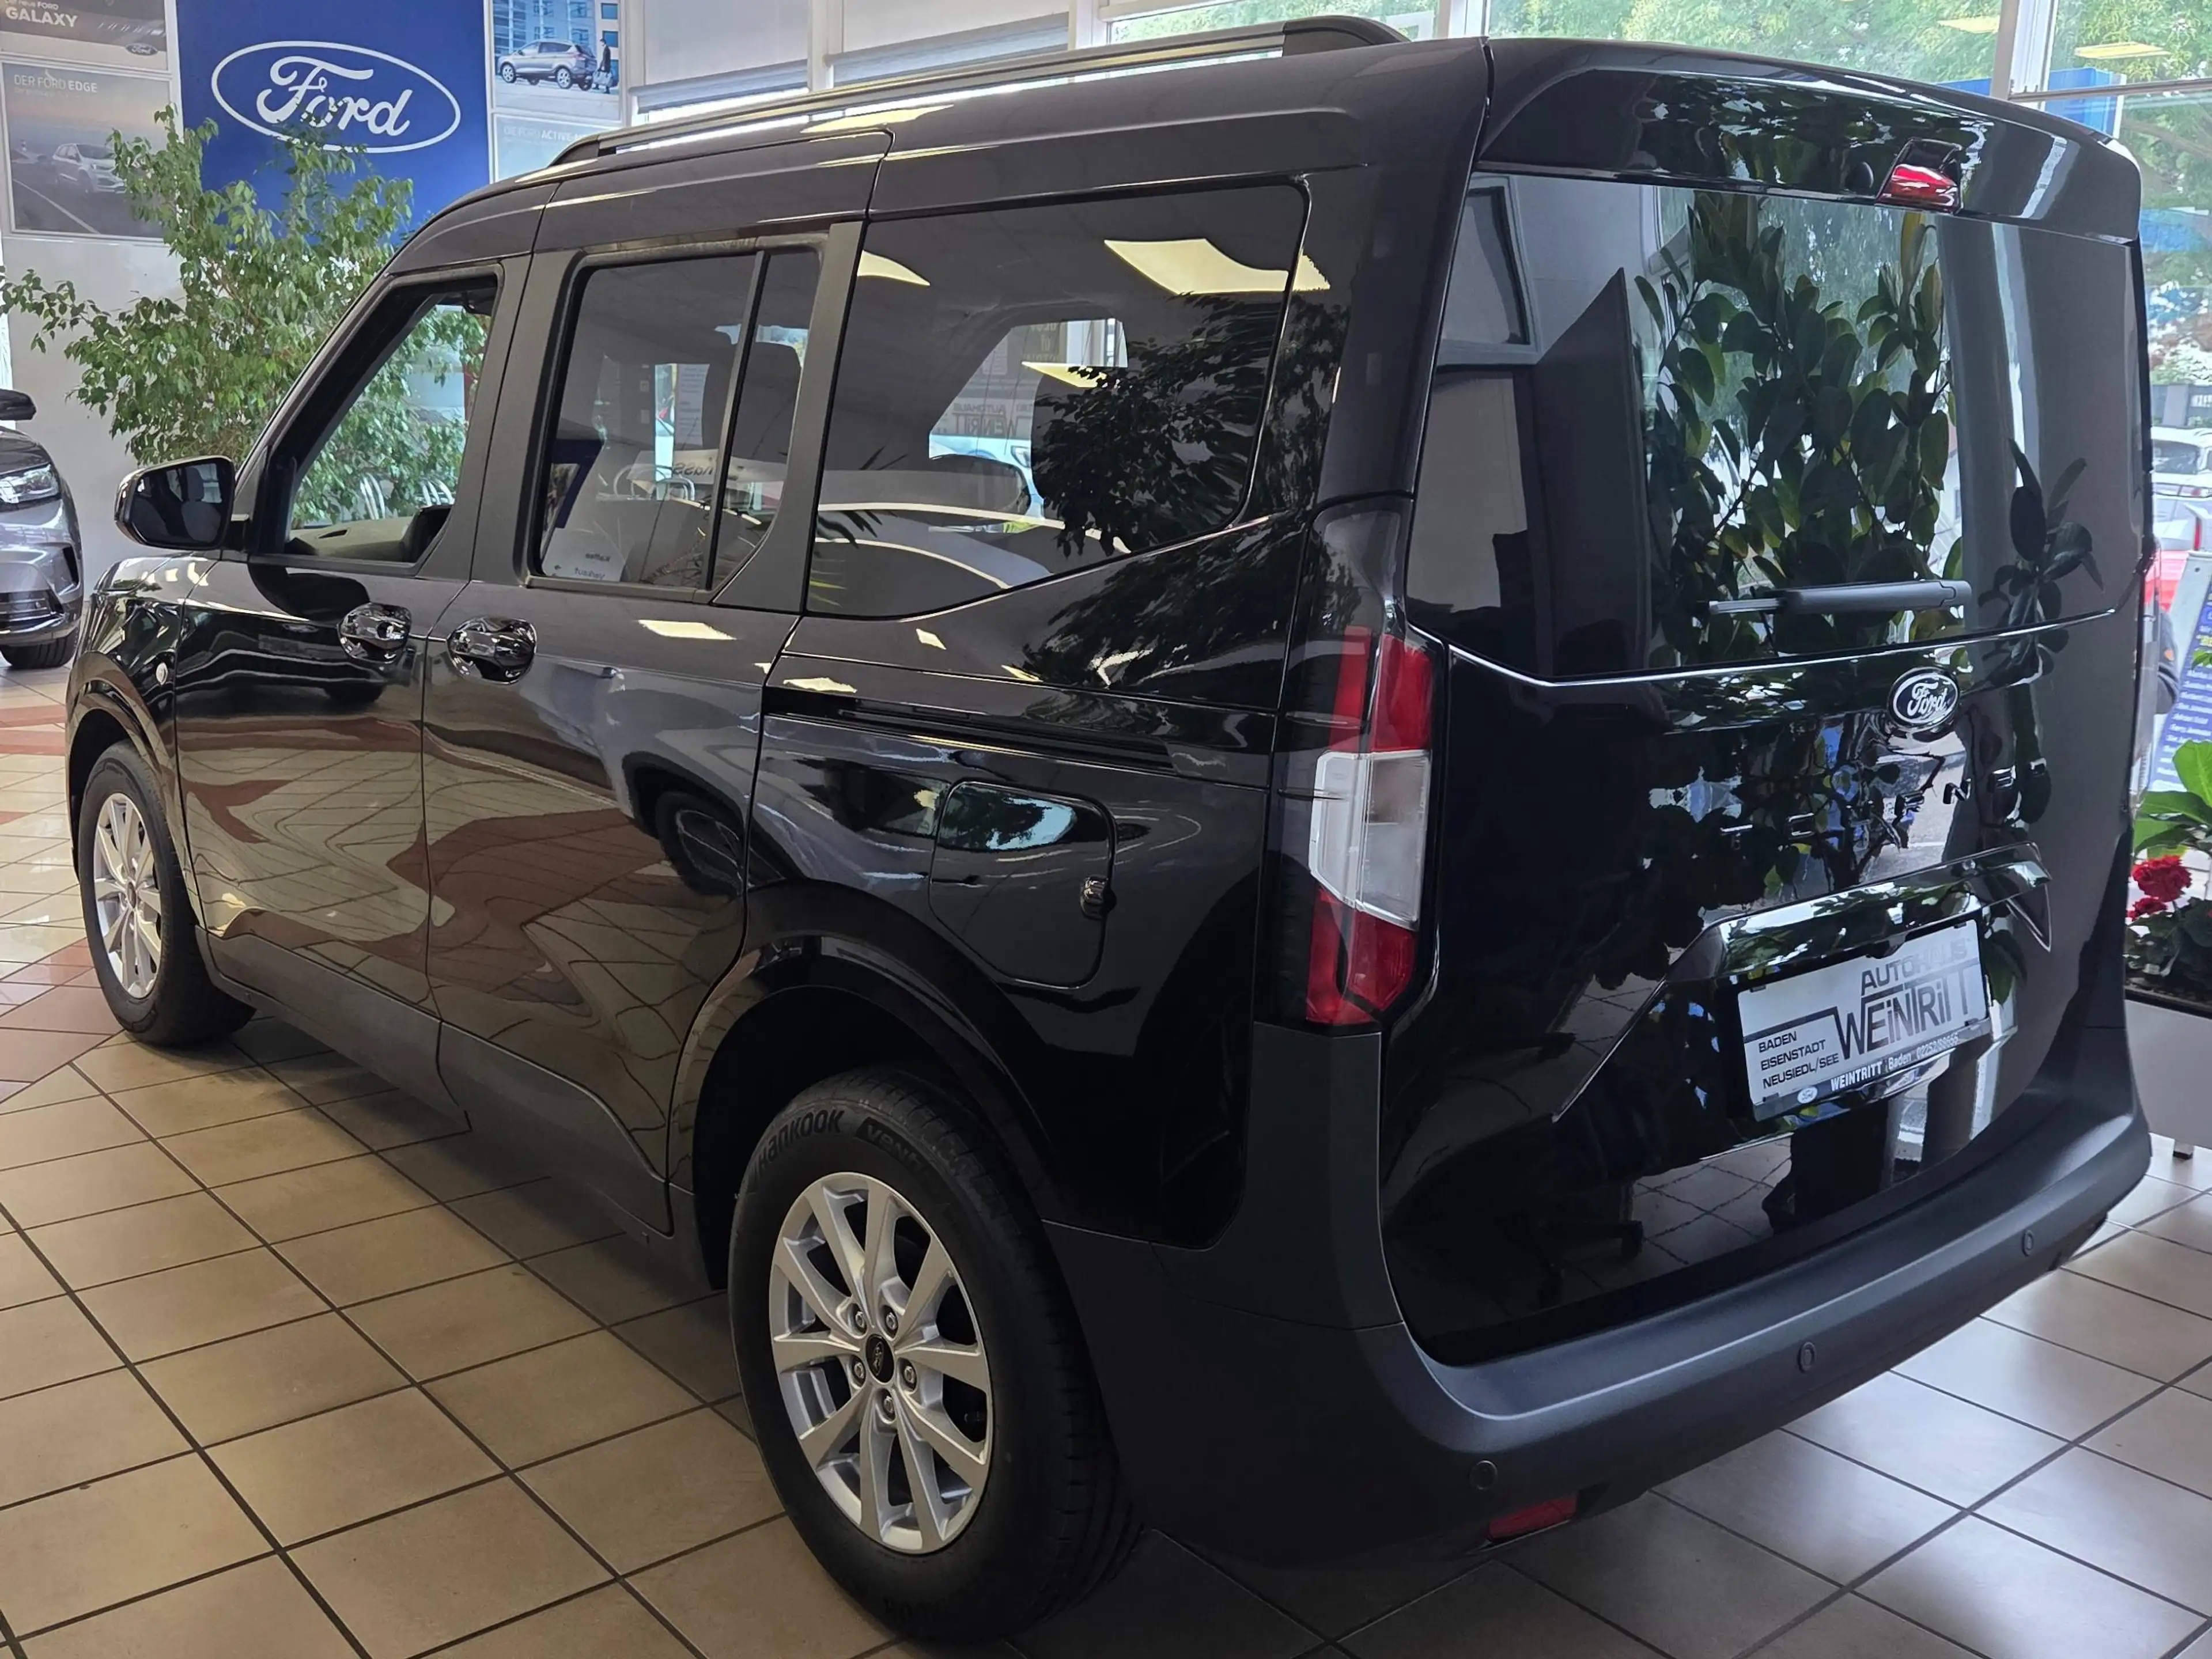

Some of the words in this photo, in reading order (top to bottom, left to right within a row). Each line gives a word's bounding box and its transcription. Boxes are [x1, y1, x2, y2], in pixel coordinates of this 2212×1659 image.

[5, 6, 78, 28] GALAXY
[37, 1, 59, 10] FORD
[14, 74, 36, 86] DER
[37, 76, 66, 90] FORD
[67, 80, 99, 93] EDGE
[256, 56, 413, 136] Ford
[1906, 681, 1949, 717] Ford
[1861, 937, 1968, 995] AUTOHAUS
[1759, 1031, 1797, 1052] BADEN
[1760, 1039, 1826, 1070] EISENSTADT
[1762, 1053, 1839, 1089] NEUSIEDL/SEE
[1830, 1062, 1882, 1092] WEINTRITT
[1888, 1052, 1912, 1070] Baden
